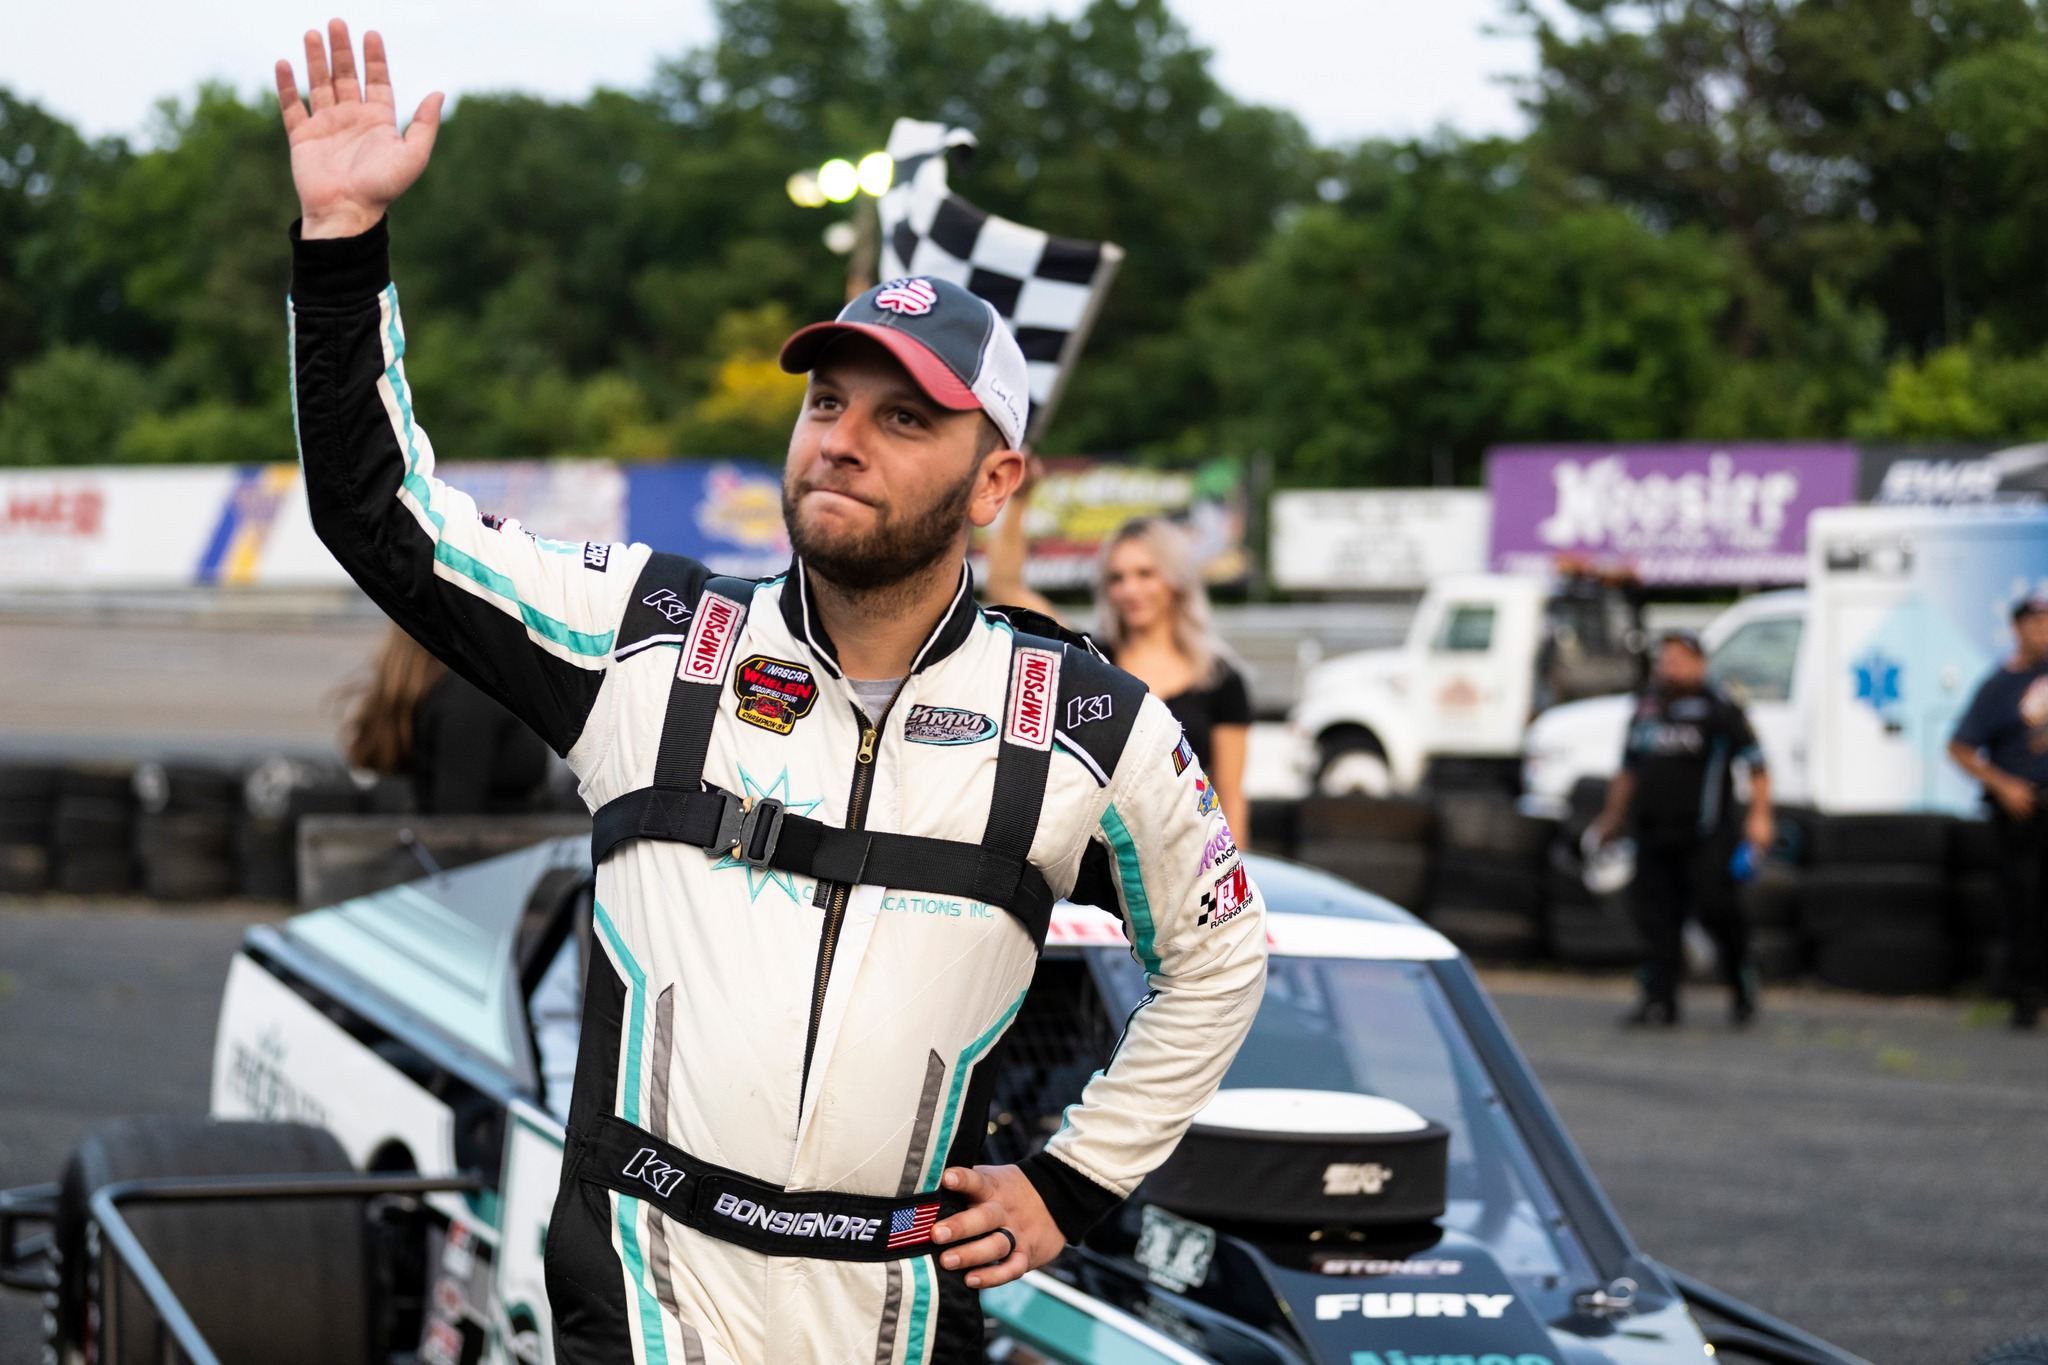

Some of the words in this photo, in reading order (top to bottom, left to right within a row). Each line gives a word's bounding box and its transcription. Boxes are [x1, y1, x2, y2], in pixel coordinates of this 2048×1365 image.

[642, 588, 693, 624] K1
[692, 602, 733, 675] SIMPSON
[743, 666, 813, 699] WHELEN
[767, 664, 809, 683] NASCAR
[749, 684, 781, 699] MODIFIED
[780, 692, 799, 703] TOUR
[1018, 658, 1048, 738] SIMPSON
[742, 712, 777, 729] CHAMPION
[910, 705, 984, 731] KMM
[1066, 694, 1113, 729] K1
[1210, 905, 1242, 930] RACING
[621, 1147, 686, 1199] K1
[712, 1192, 883, 1242] BONSIGNORE
[1314, 1292, 1514, 1320] FURY
